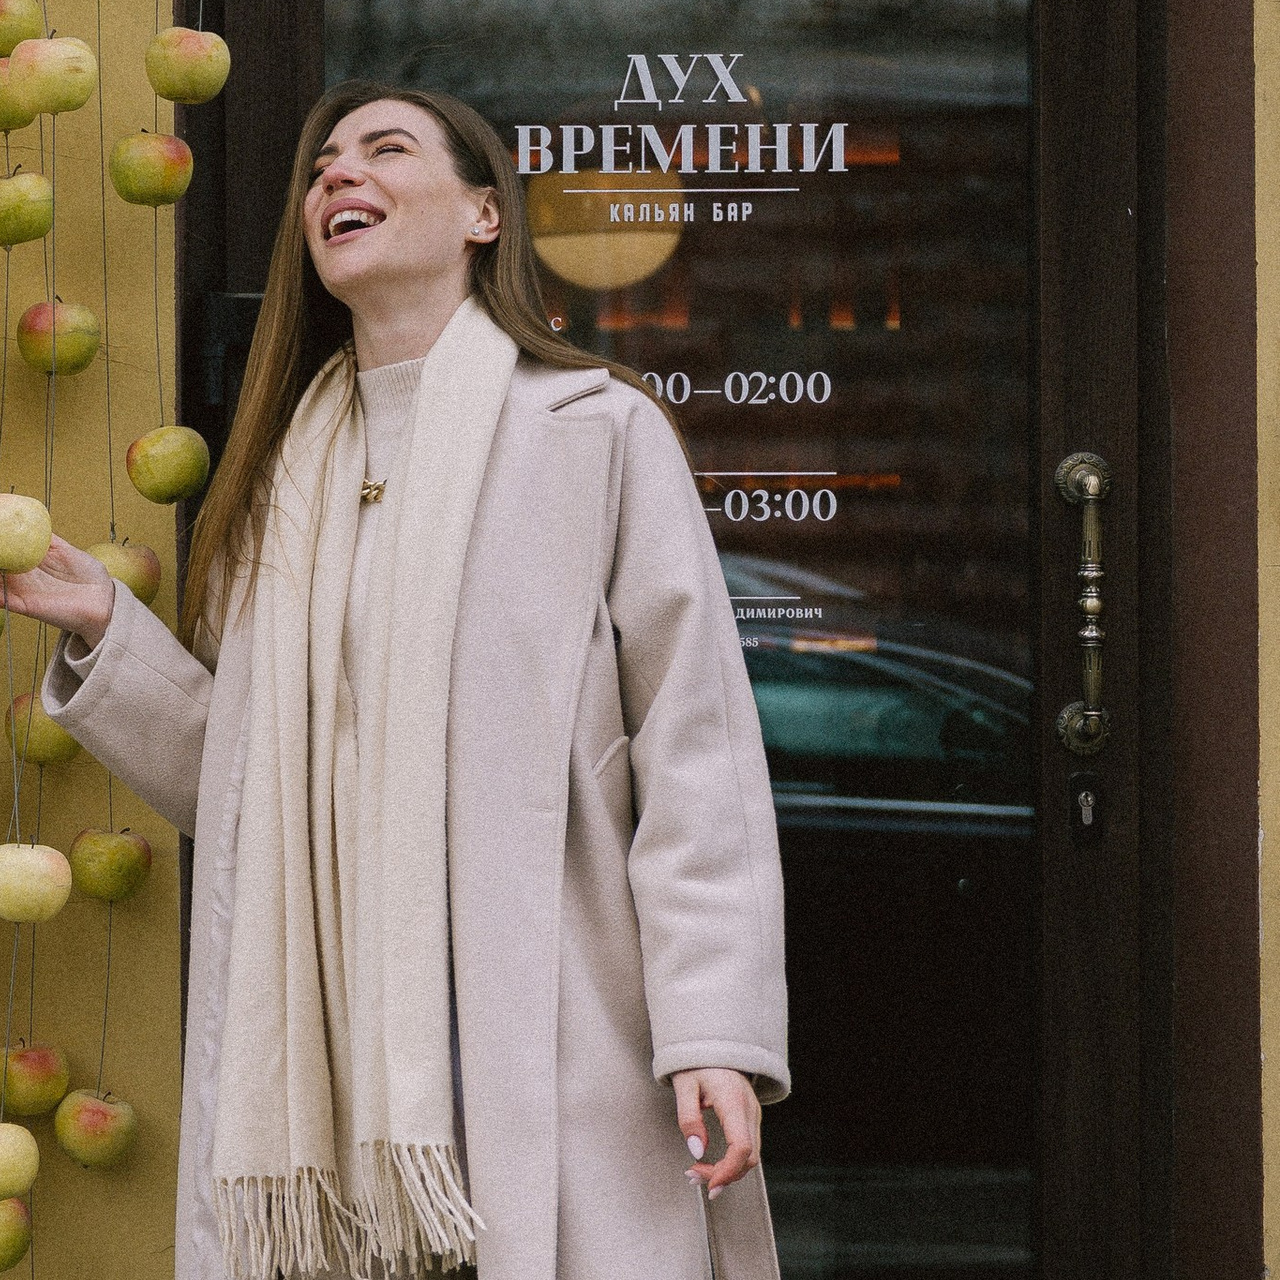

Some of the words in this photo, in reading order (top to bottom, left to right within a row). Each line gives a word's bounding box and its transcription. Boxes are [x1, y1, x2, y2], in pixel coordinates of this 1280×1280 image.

[614, 53, 748, 112] ДУХ
[514, 123, 849, 175] ВРЕМЕНИ
[610, 203, 694, 222] КАЛЬЯН
[713, 202, 753, 222] БАР
